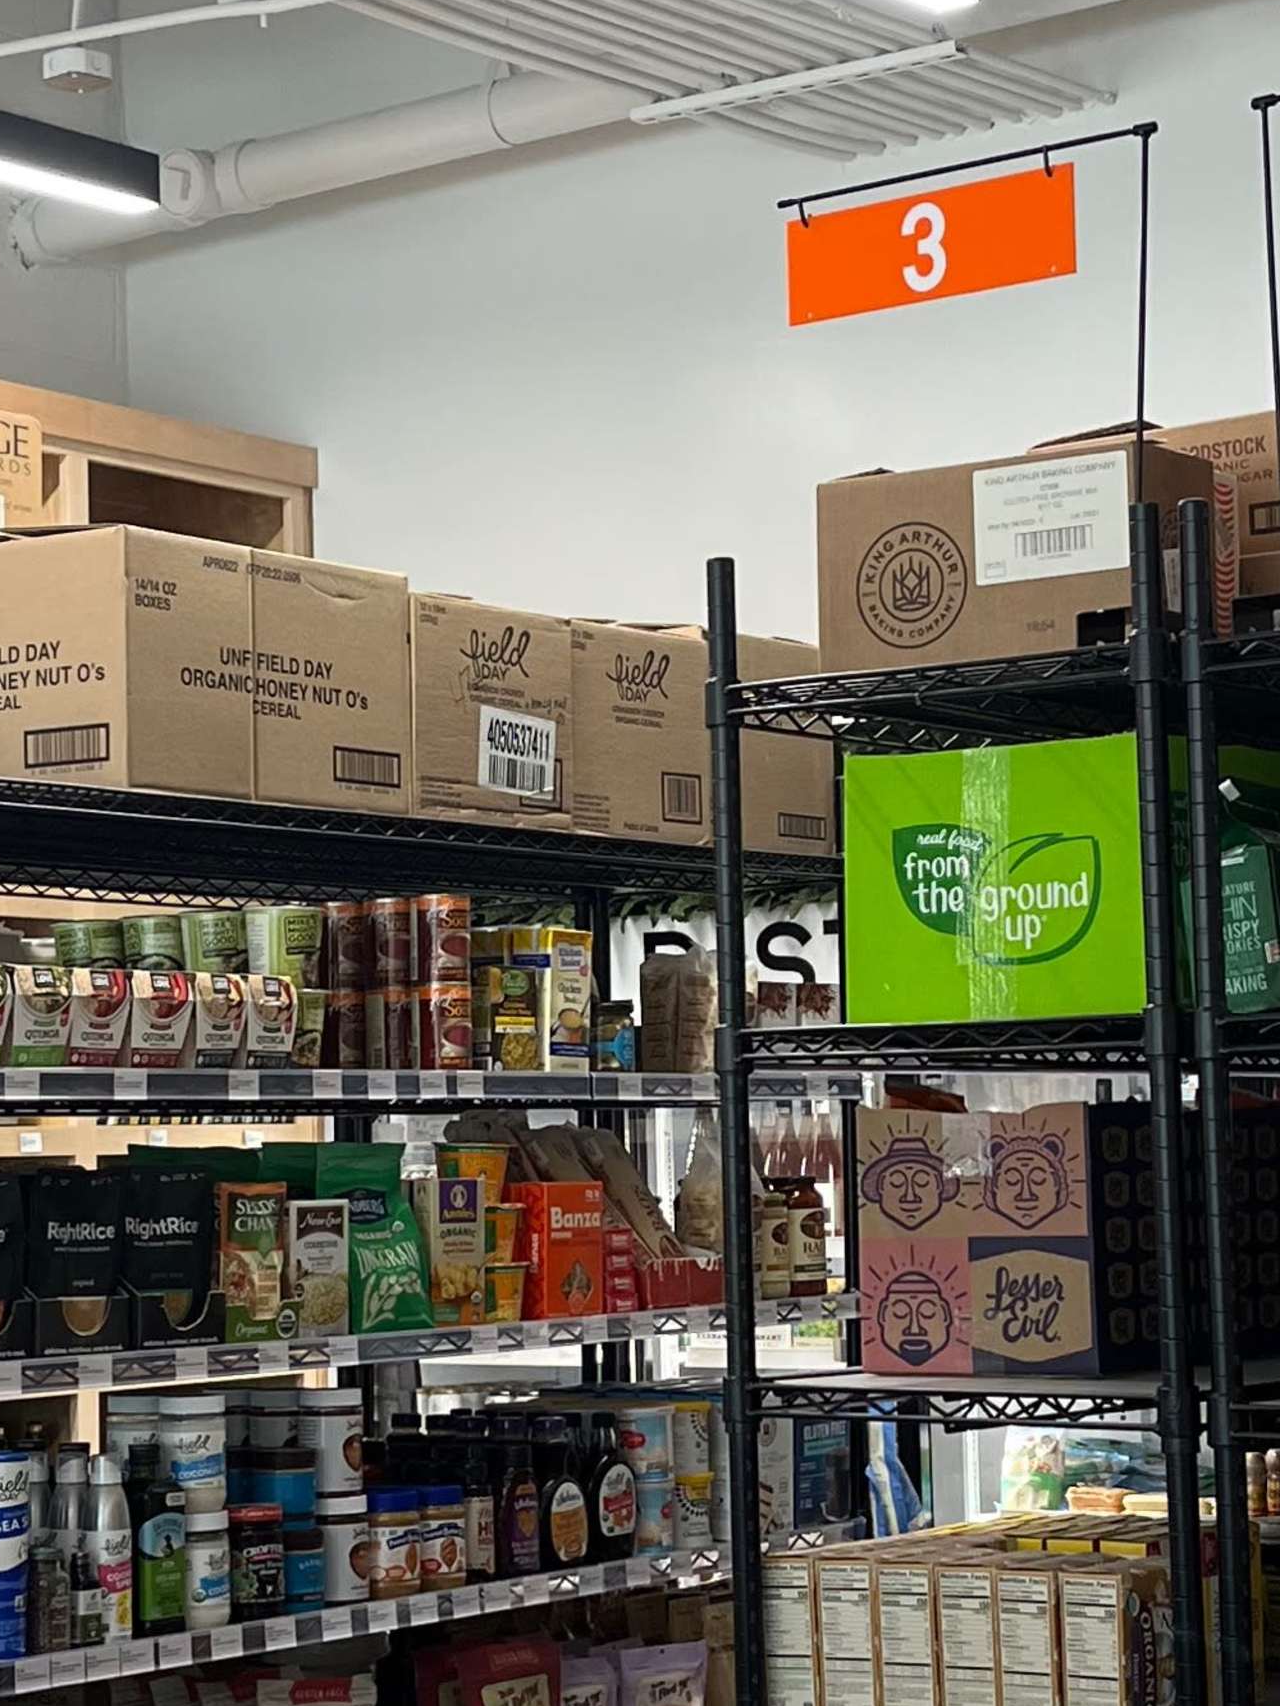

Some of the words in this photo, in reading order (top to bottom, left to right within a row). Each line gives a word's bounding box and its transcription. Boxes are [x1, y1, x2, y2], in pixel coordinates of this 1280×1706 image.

[900, 202, 948, 294] 3
[1180, 435, 1266, 459] ODSTOCK
[1042, 466, 1072, 479] BAKING
[1073, 460, 1116, 476] COMPANY
[865, 538, 894, 584] KING
[899, 530, 958, 576] ARTHUR
[162, 581, 177, 595] OZ
[135, 594, 170, 610] BOXES
[868, 604, 903, 638] BAKING
[910, 596, 956, 638] COMPANY
[25, 640, 60, 662] DAY
[460, 625, 530, 678] field
[36, 666, 70, 686] NUT
[77, 662, 105, 683] O's
[220, 647, 252, 667] UNF
[256, 653, 299, 675] FIELD
[304, 660, 332, 680] DAY
[481, 663, 510, 681] DAY
[606, 650, 670, 701] field
[180, 667, 253, 693] ORGANIC
[256, 677, 308, 702] HONEY
[312, 688, 341, 705] NUT
[346, 691, 368, 710] O's
[625, 687, 651, 703] DAY
[252, 699, 301, 720] CEREAL
[487, 717, 550, 762] 4050537411
[916, 829, 945, 845] real
[904, 852, 968, 880] from
[912, 881, 964, 914] the
[980, 871, 1089, 922] ground
[1005, 913, 1042, 950] up
[125, 1216, 200, 1239] RightRice
[550, 1206, 601, 1229] Banza
[440, 1229, 477, 1239] ORGANIC
[984, 1265, 1066, 1319] Lesser
